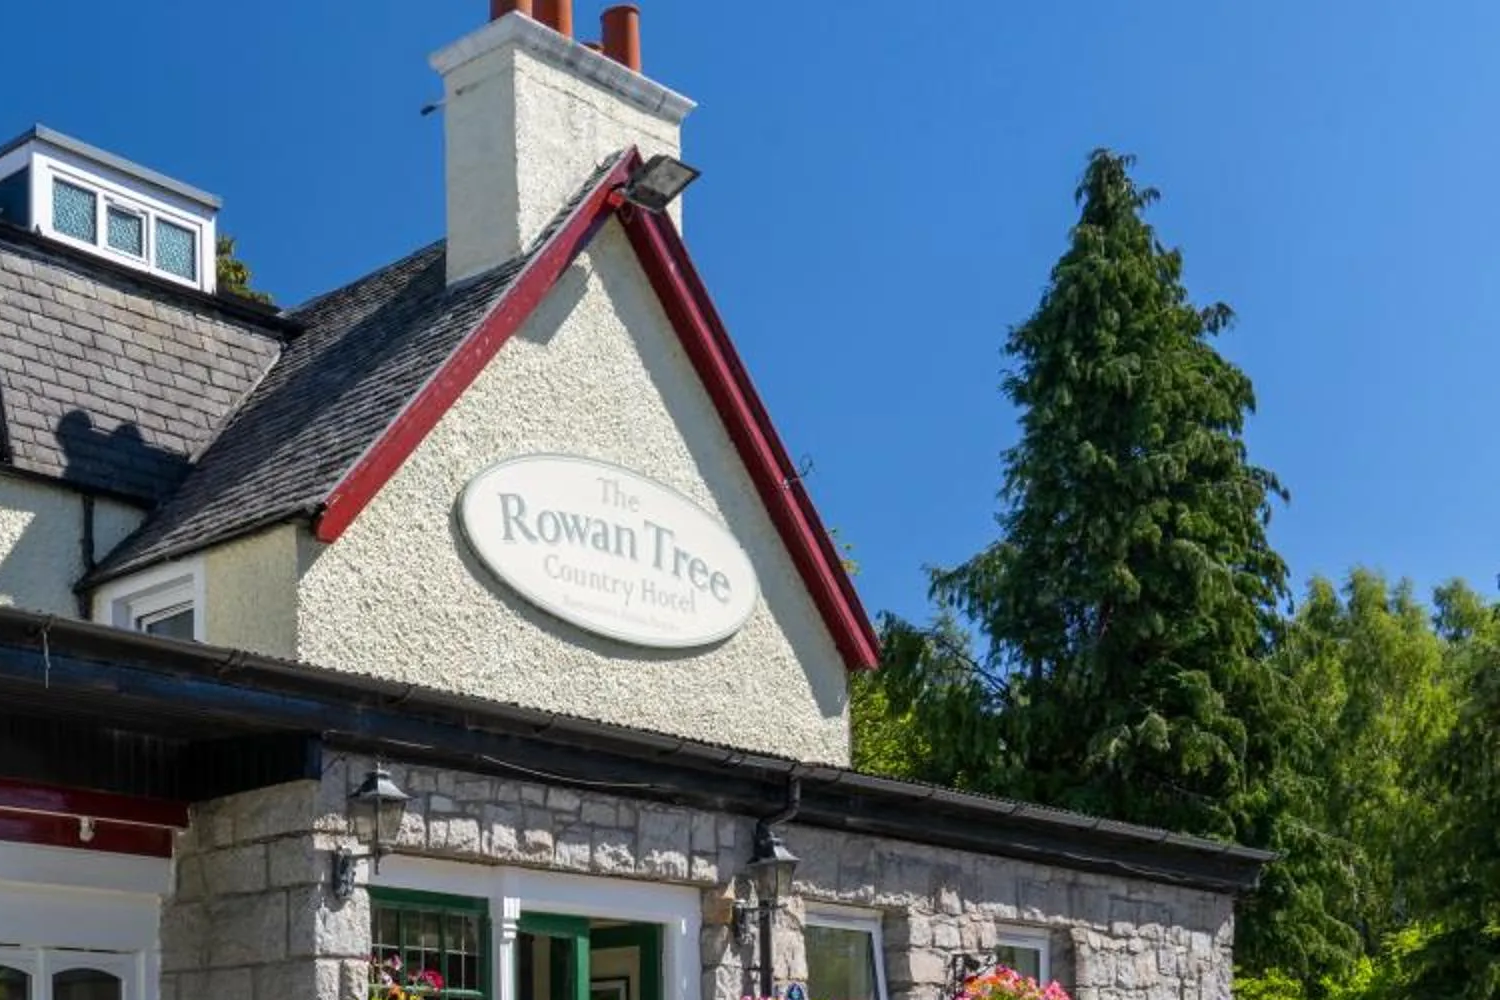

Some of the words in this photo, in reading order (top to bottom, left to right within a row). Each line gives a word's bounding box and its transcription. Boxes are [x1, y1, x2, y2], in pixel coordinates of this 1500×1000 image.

[596, 477, 640, 512] The
[497, 493, 637, 562] Rowan
[644, 519, 732, 604] Tree
[543, 554, 634, 606] Country
[641, 579, 697, 614] Hotel
